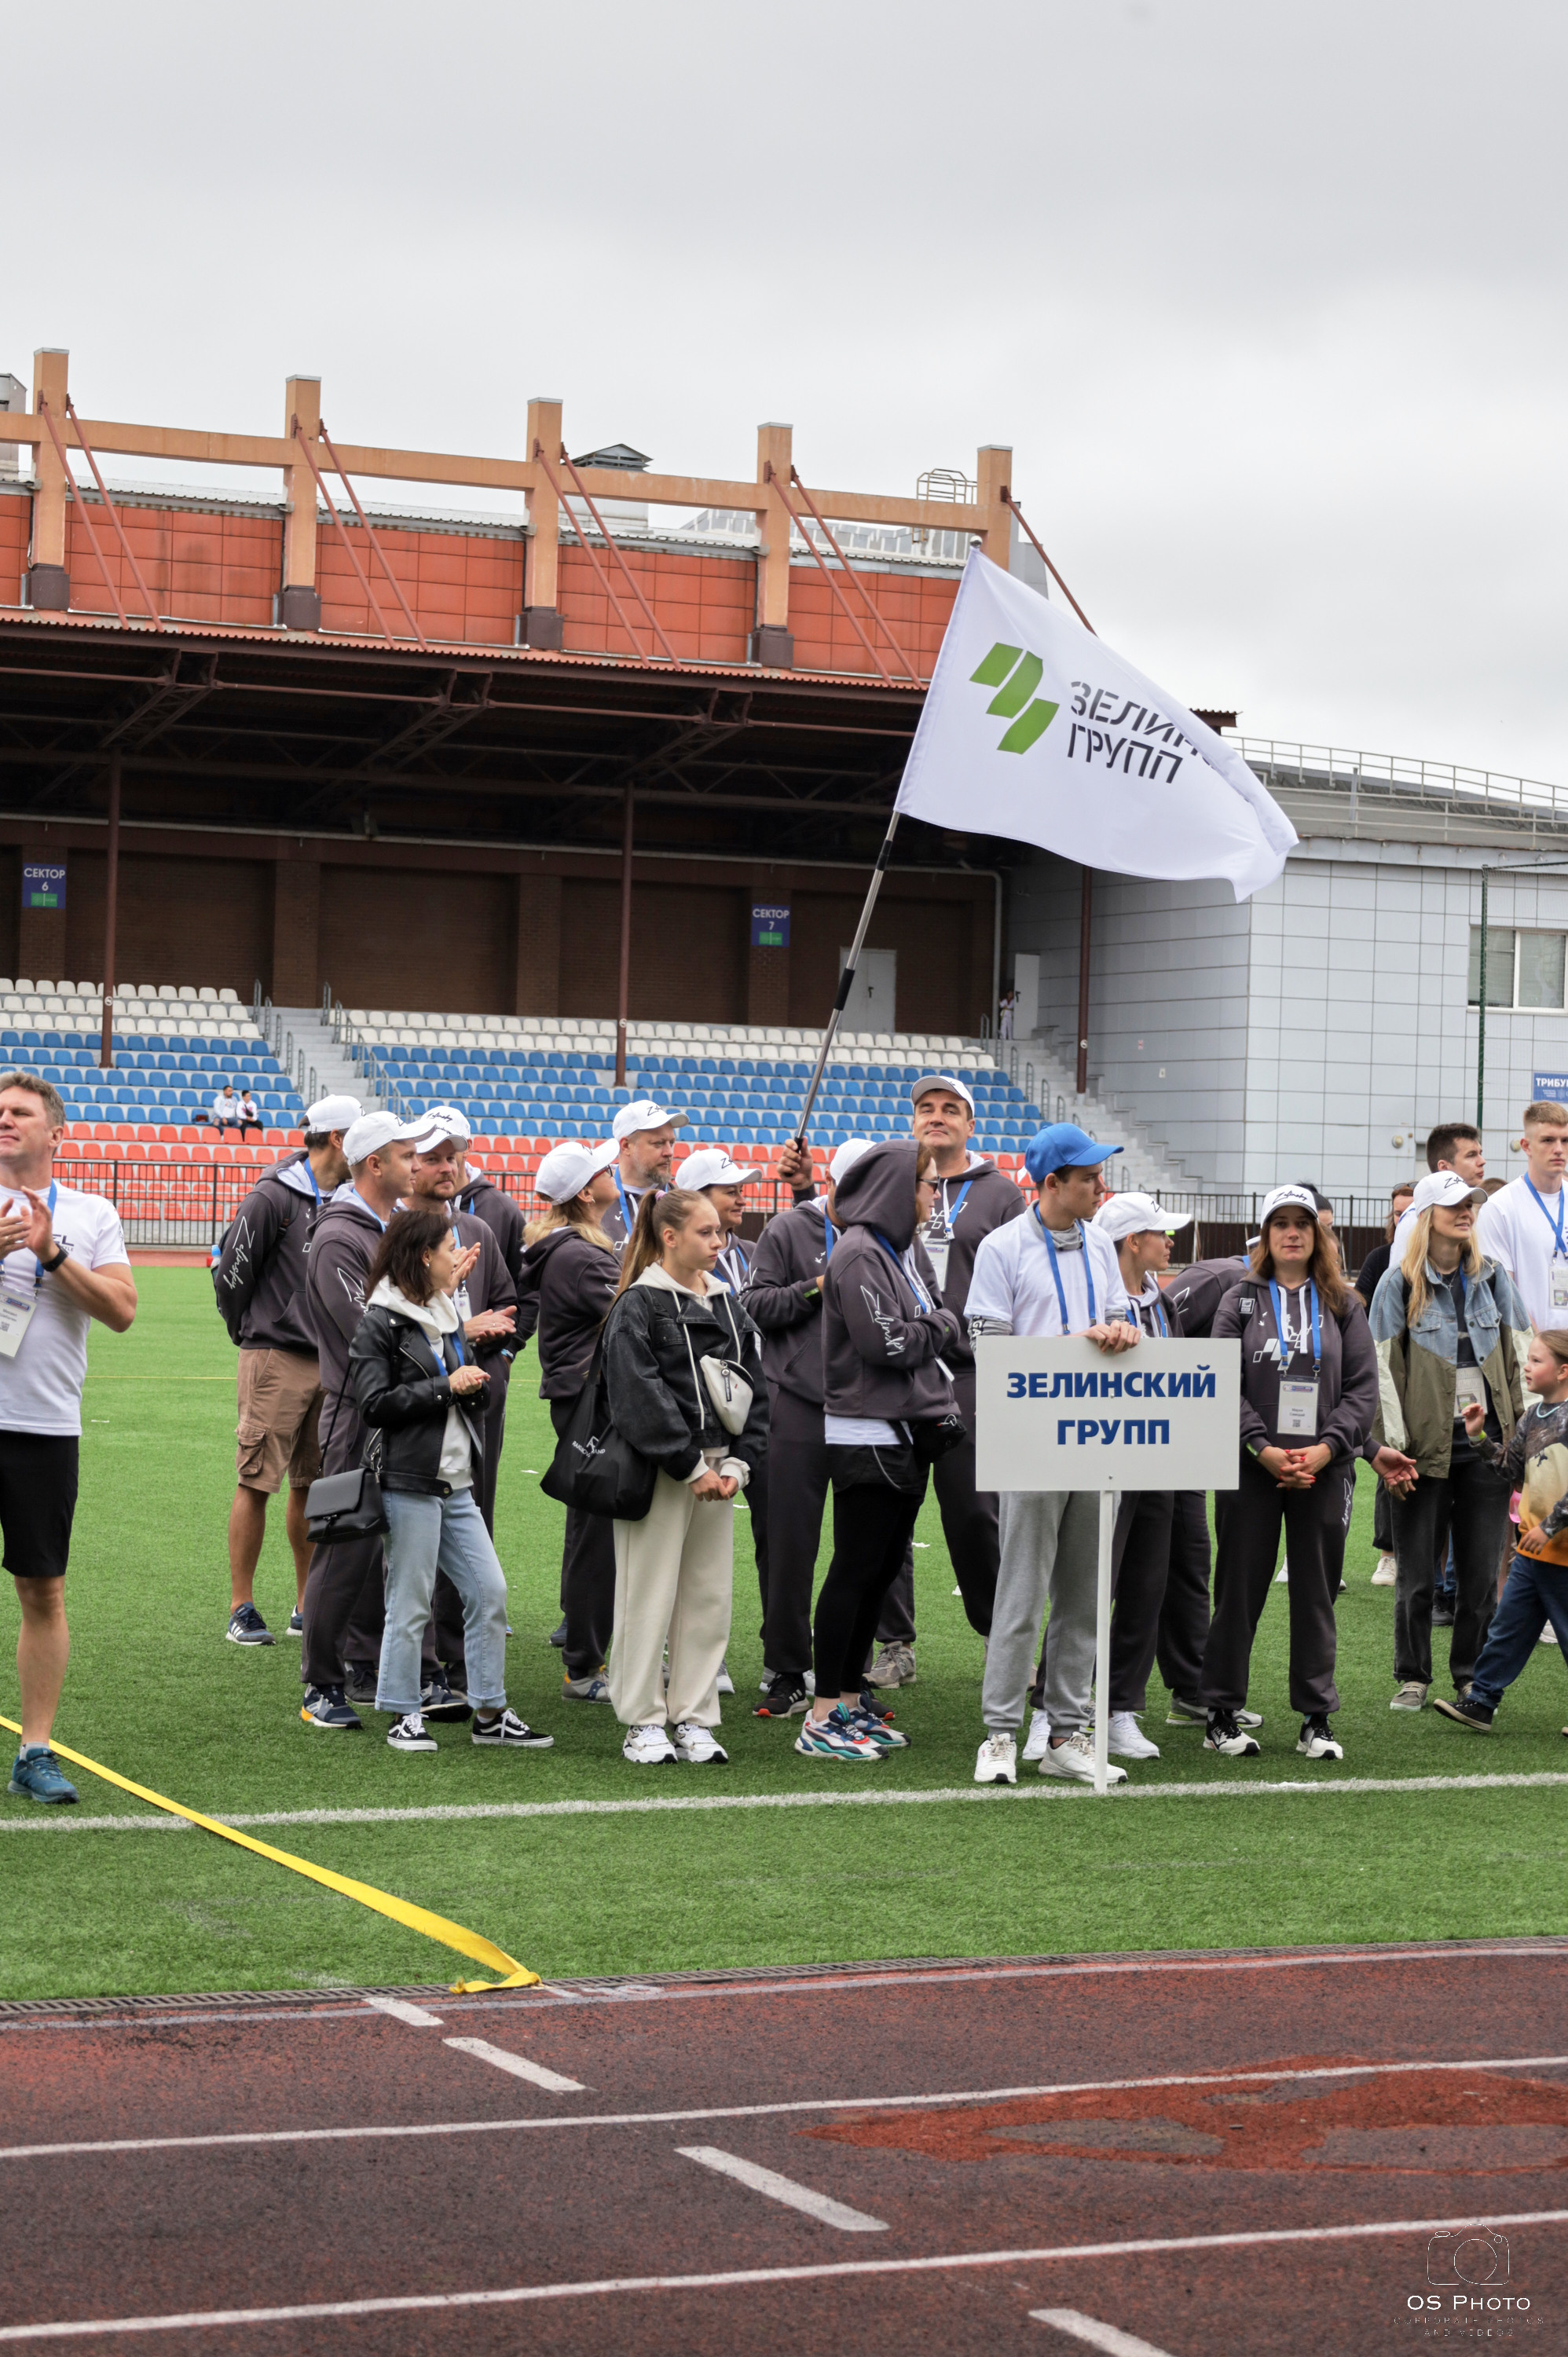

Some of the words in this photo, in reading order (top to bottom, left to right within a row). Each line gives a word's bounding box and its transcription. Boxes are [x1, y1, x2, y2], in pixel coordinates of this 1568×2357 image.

[1067, 723, 1183, 783] ГРУПП
[24, 867, 66, 879] СЕКТОР
[42, 882, 49, 892] 6
[753, 908, 789, 918] СЕКТОР
[768, 921, 775, 930] 7
[1006, 1365, 1216, 1398] ЗЕЛИНСКИЙ
[1057, 1419, 1170, 1445] ГРУПП
